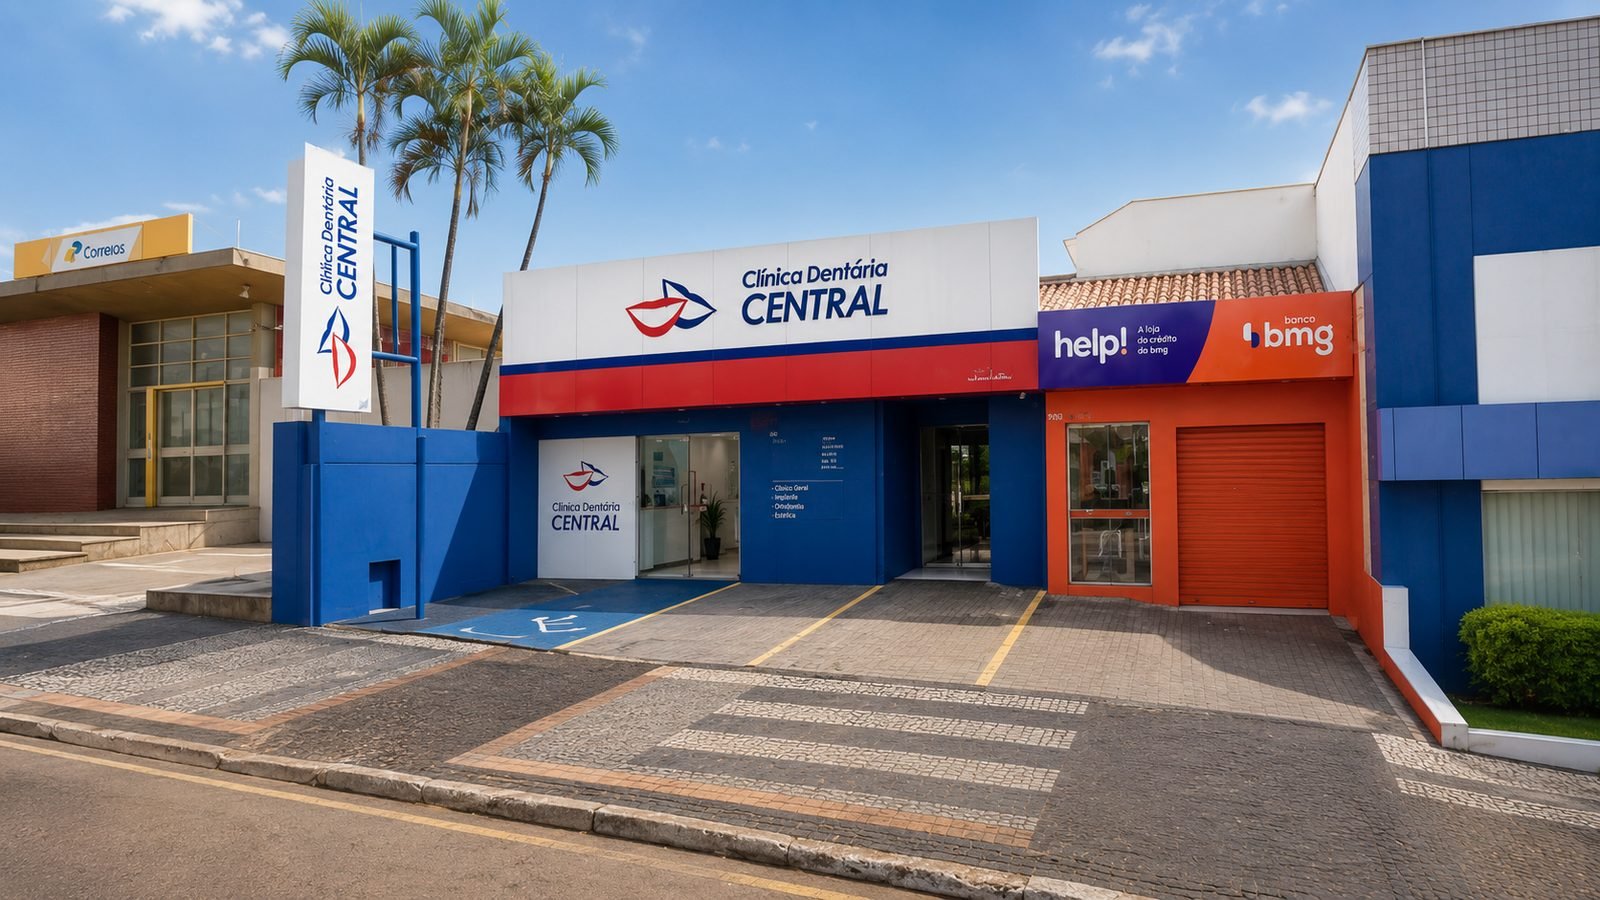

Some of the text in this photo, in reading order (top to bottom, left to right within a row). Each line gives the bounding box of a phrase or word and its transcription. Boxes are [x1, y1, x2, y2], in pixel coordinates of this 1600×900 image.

[321, 176, 334, 242] Dentária
[336, 186, 358, 300] CENTRAL
[742, 258, 888, 289] Clínica Dentária
[741, 283, 888, 326] CENTRAL
[1054, 326, 1127, 364] help!
[1145, 325, 1160, 335] loja
[1264, 321, 1334, 356] bmg
[1150, 346, 1168, 355] bmg
[551, 514, 620, 531] CENTRAL
[582, 501, 620, 512] Dentária
